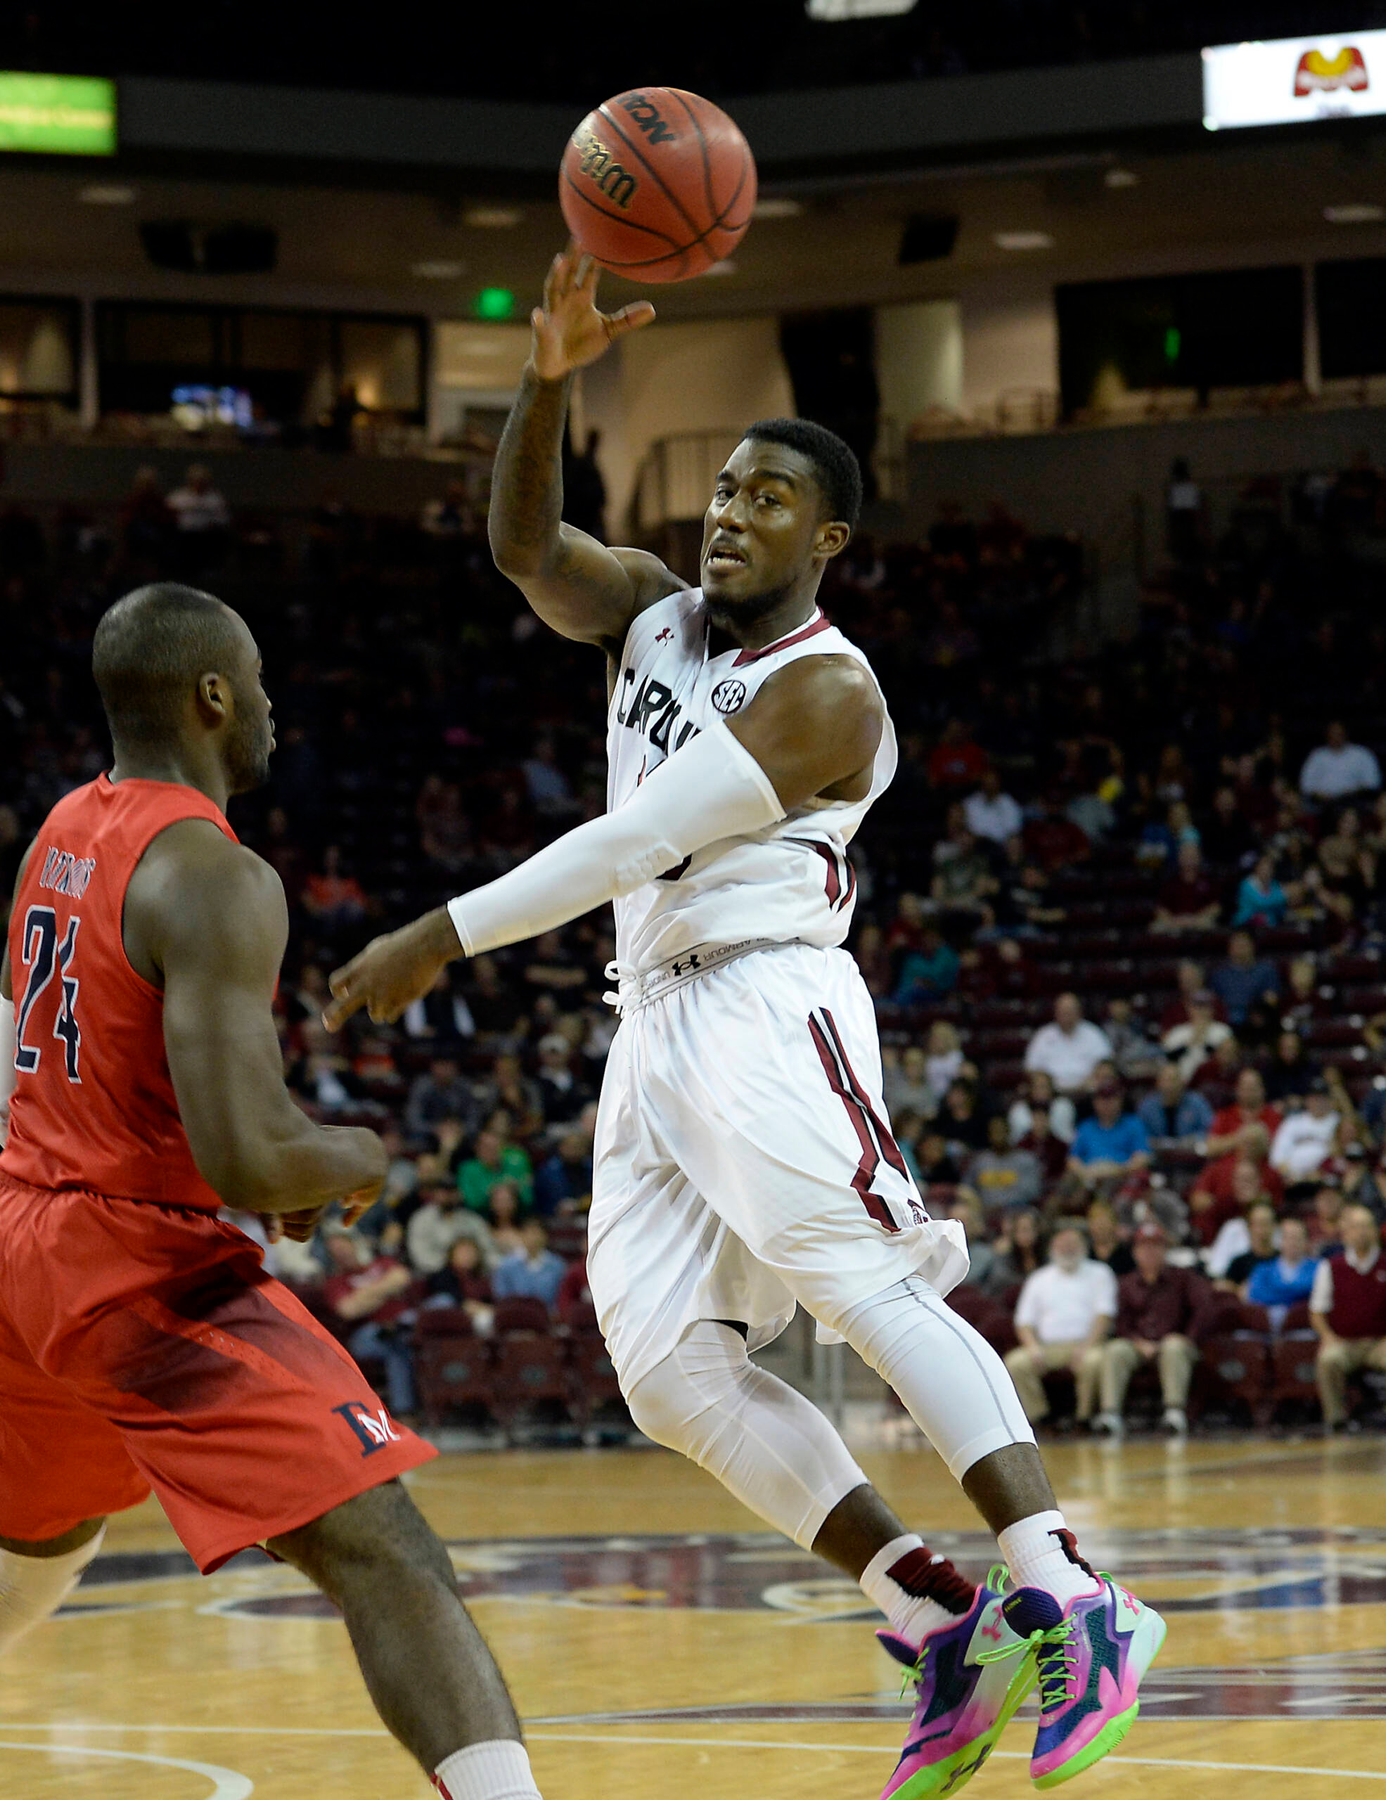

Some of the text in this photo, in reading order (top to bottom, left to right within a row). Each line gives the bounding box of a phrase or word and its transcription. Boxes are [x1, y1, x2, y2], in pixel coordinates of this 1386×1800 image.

[573, 133, 637, 209] Wils
[711, 680, 746, 714] SEC
[14, 904, 82, 1084] 24
